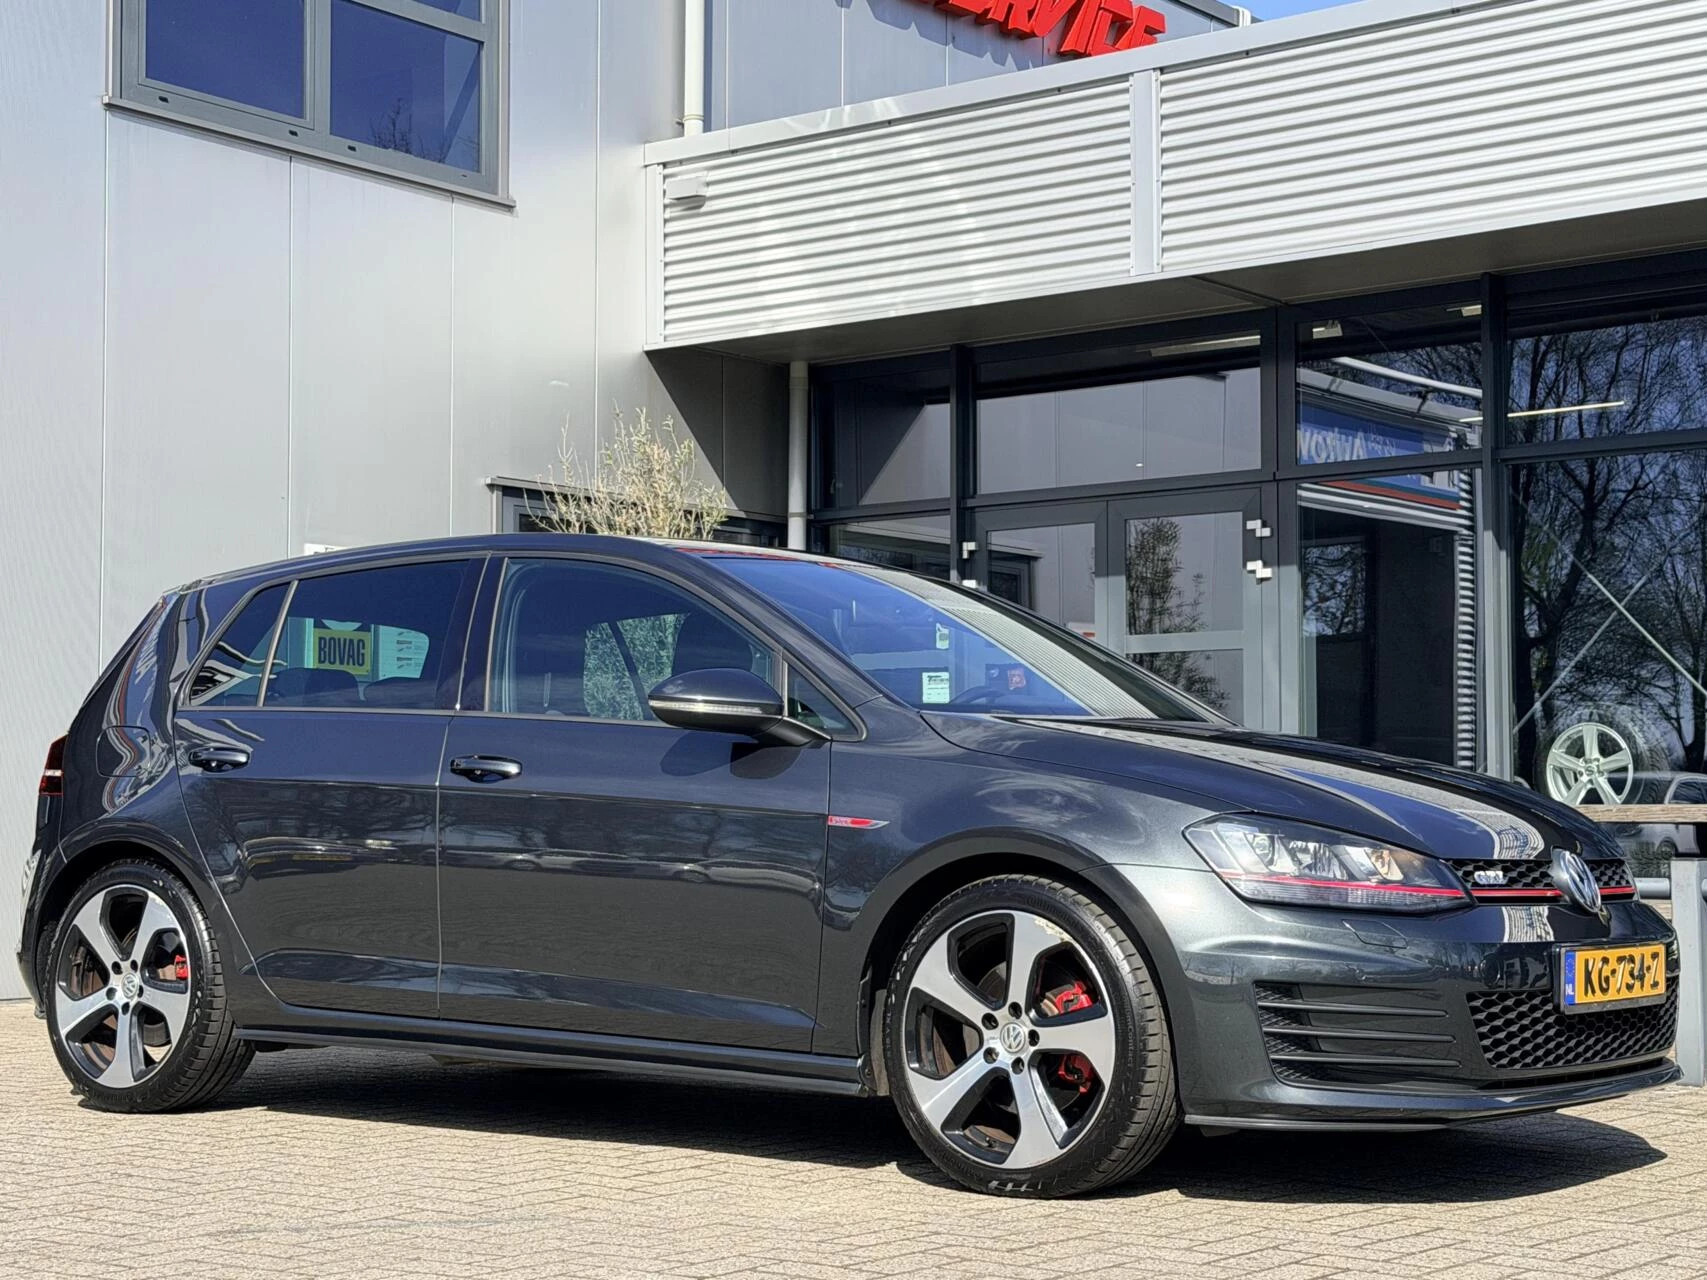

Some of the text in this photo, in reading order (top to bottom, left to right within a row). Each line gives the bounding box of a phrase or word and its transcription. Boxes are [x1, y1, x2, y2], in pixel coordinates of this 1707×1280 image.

[318, 636, 366, 667] BOVAG
[1565, 983, 1575, 996] NL
[1584, 952, 1660, 998] KG-734-Z
